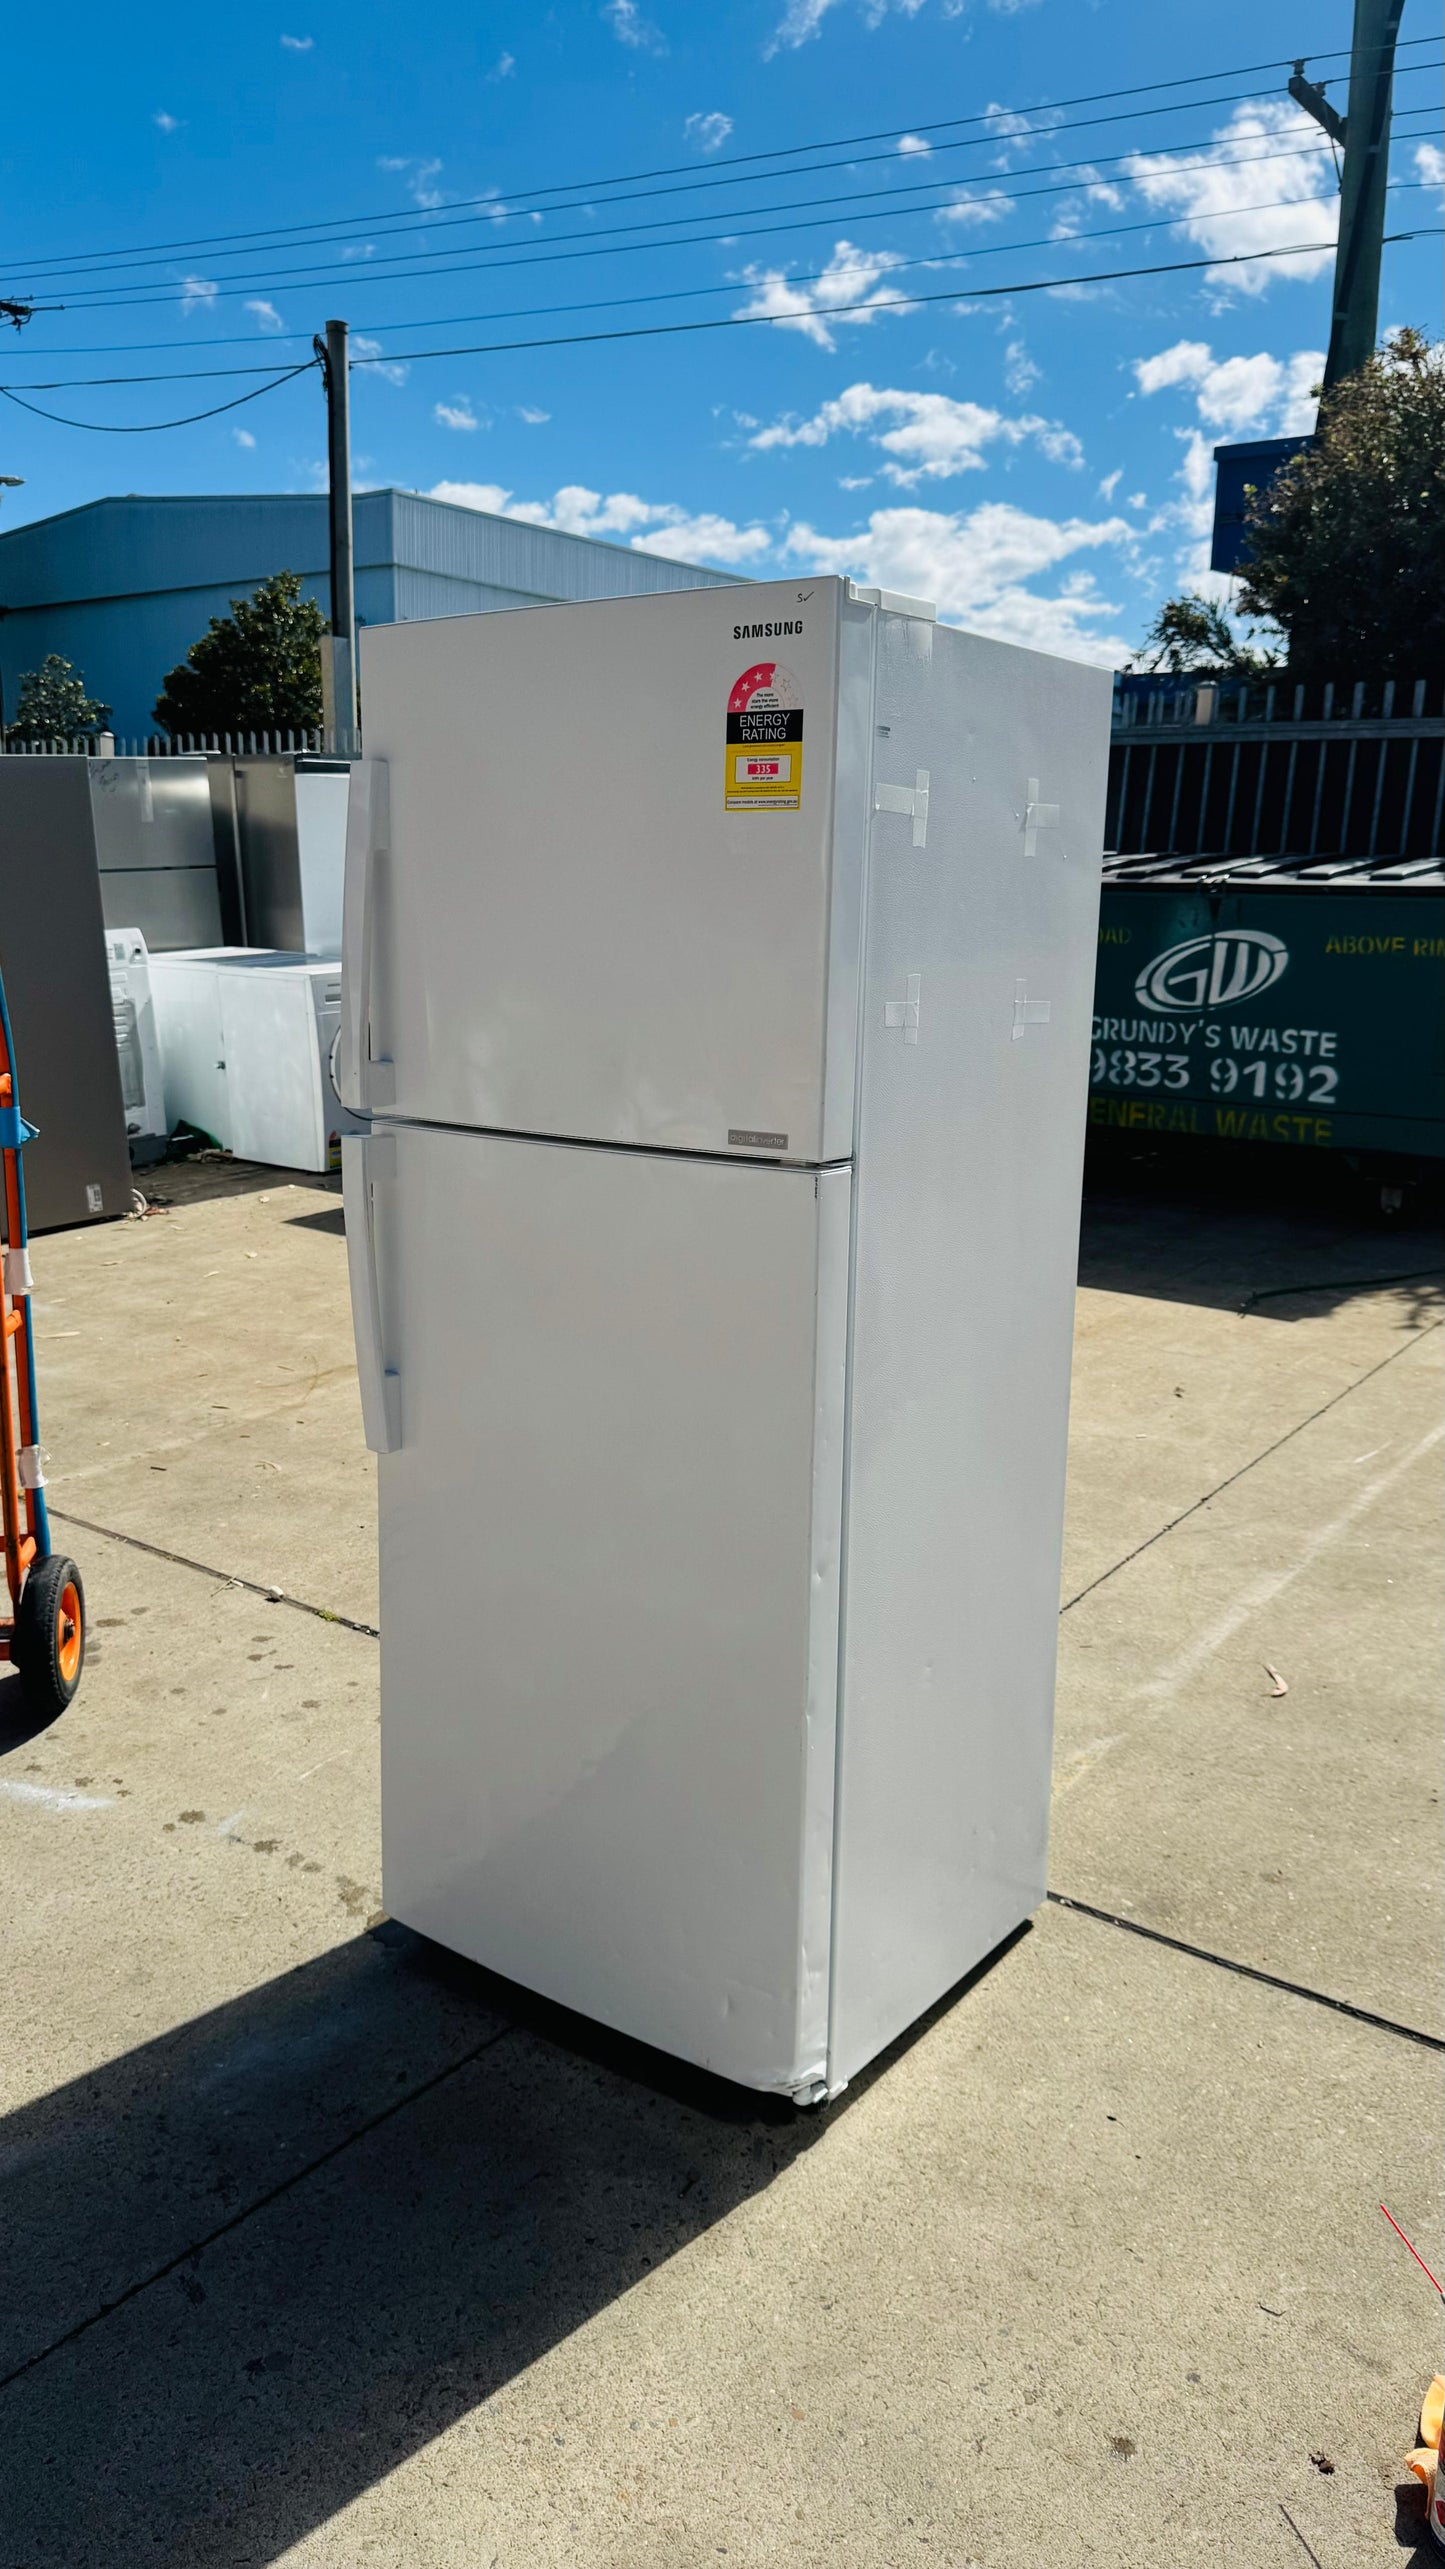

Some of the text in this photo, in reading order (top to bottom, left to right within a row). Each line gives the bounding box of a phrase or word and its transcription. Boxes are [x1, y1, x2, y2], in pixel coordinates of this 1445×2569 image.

[733, 620, 803, 639] SAMSUNG
[739, 713, 790, 727] ENERGY
[742, 727, 787, 741] RATING
[756, 764, 771, 774] 335
[1325, 936, 1406, 954] ABOVE
[1091, 1016, 1338, 1058] GRUNDY'S WASTE
[1210, 1058, 1340, 1104] 9192
[1091, 1098, 1333, 1146] ENERAL WASTE
